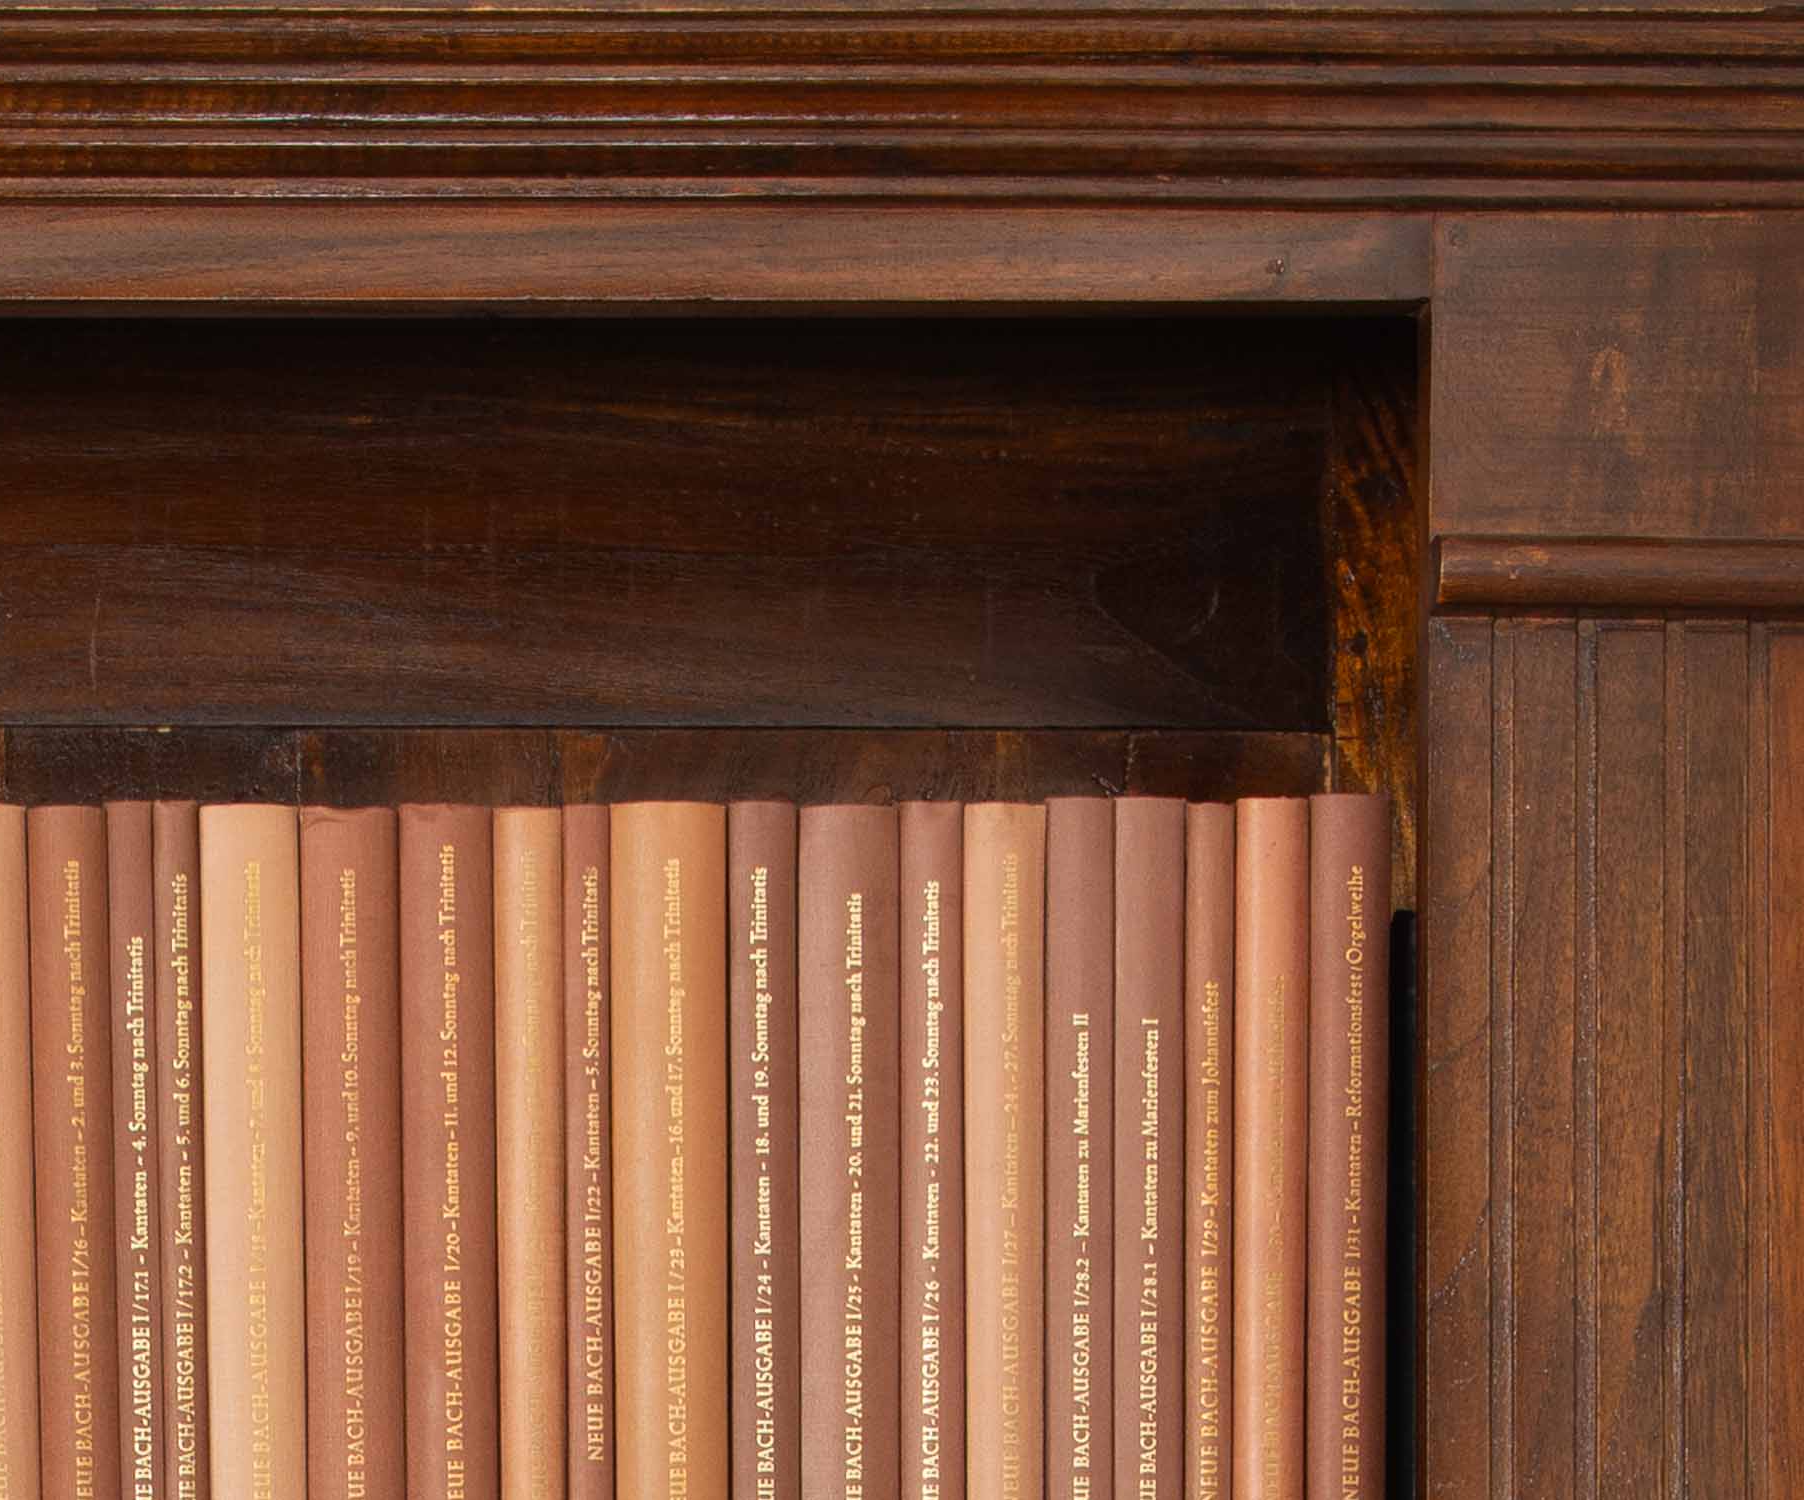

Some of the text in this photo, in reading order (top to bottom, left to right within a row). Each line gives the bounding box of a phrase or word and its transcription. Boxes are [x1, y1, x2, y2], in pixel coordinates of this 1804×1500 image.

[749, 866, 768, 944] Trinitatis
[125, 935, 144, 1016] Trinitatis
[749, 947, 768, 989] nach
[125, 1016, 145, 1058] nach
[750, 991, 773, 1062] Sonntag
[1072, 1012, 1089, 1025] II
[127, 1060, 149, 1131] Sonntag
[751, 1094, 770, 1128] und
[753, 1064, 769, 1088] 19.
[1071, 1030, 1089, 1135] Marienfesten
[131, 1134, 147, 1151] 4.
[755, 1131, 770, 1154] 18.
[1078, 1138, 1089, 1158] zu
[130, 1169, 149, 1250] Kantaten
[753, 1175, 771, 1254] Kantaten
[1072, 1163, 1090, 1237] Kantaten
[1073, 1257, 1090, 1306] I/28.2
[131, 1326, 152, 1480] BACH-AUSGABE
[754, 1318, 775, 1472] BACH-AUSGABE
[1072, 1312, 1090, 1467] BACH-AUSGABE
